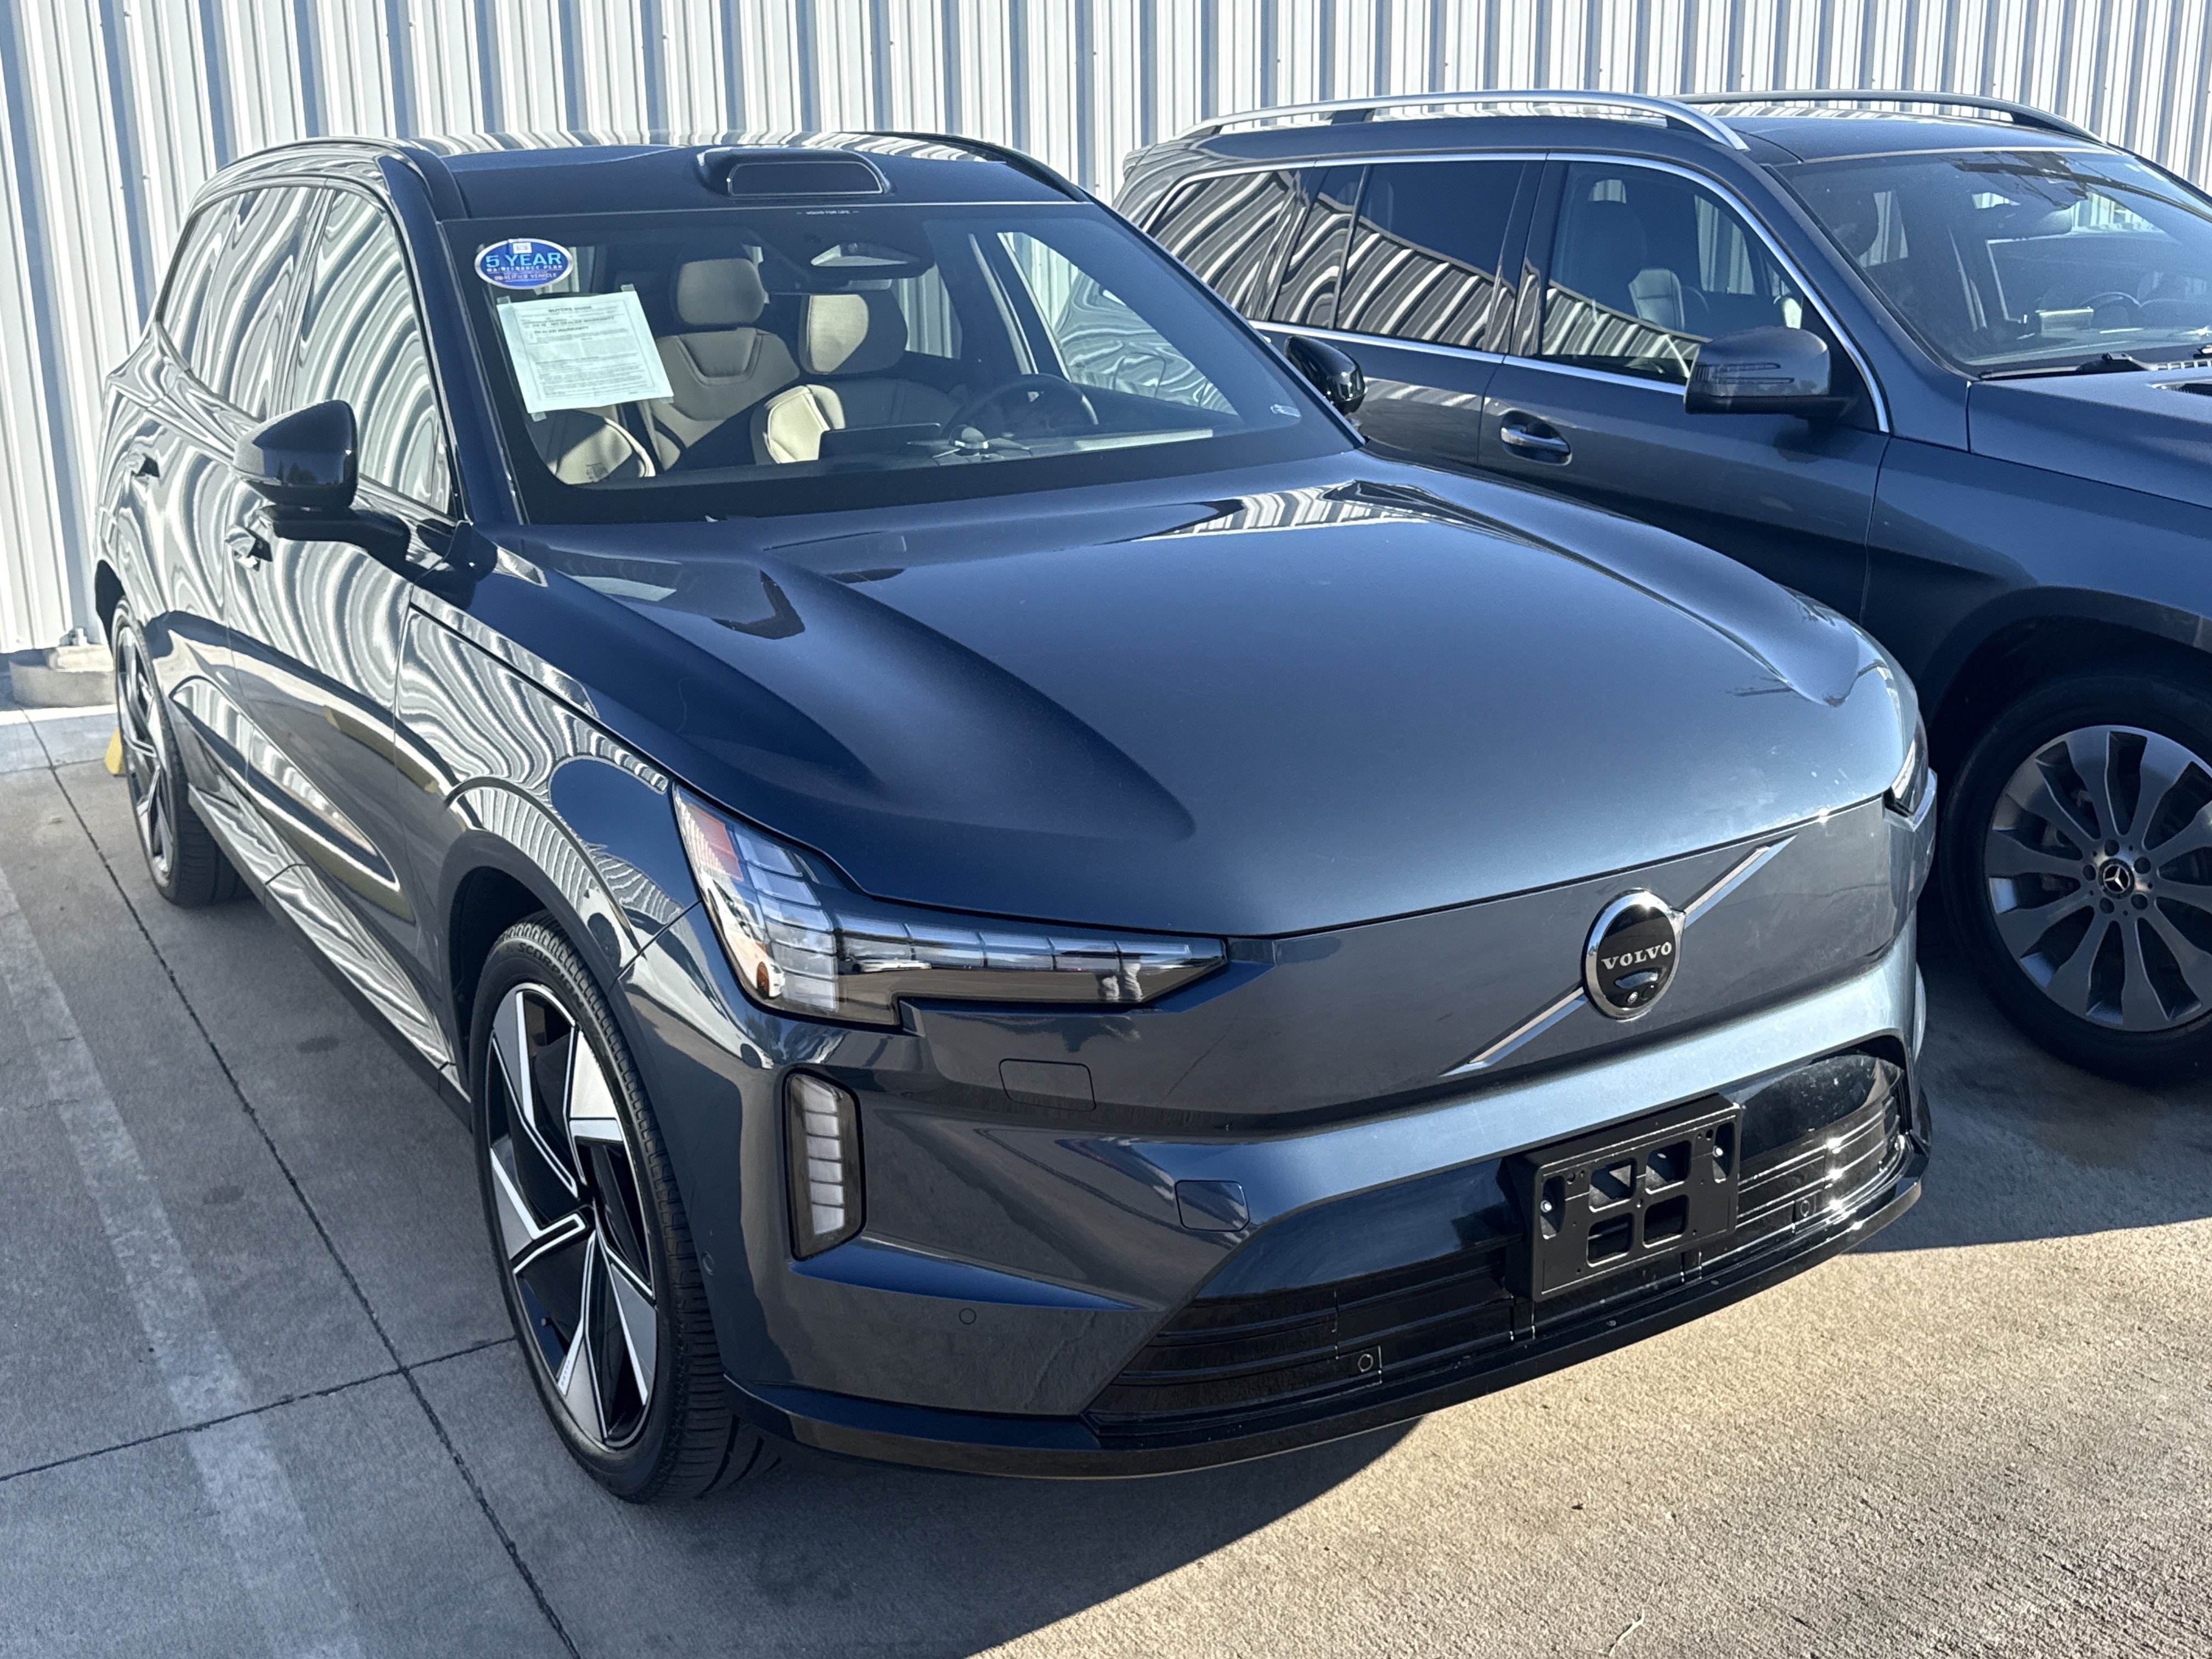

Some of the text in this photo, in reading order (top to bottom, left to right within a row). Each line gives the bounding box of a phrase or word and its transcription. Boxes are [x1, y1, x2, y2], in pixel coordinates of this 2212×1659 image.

[486, 252, 562, 268] 5 YEAR
[1601, 942, 1672, 969] VOLVO
[517, 942, 584, 1010] SCORPION
